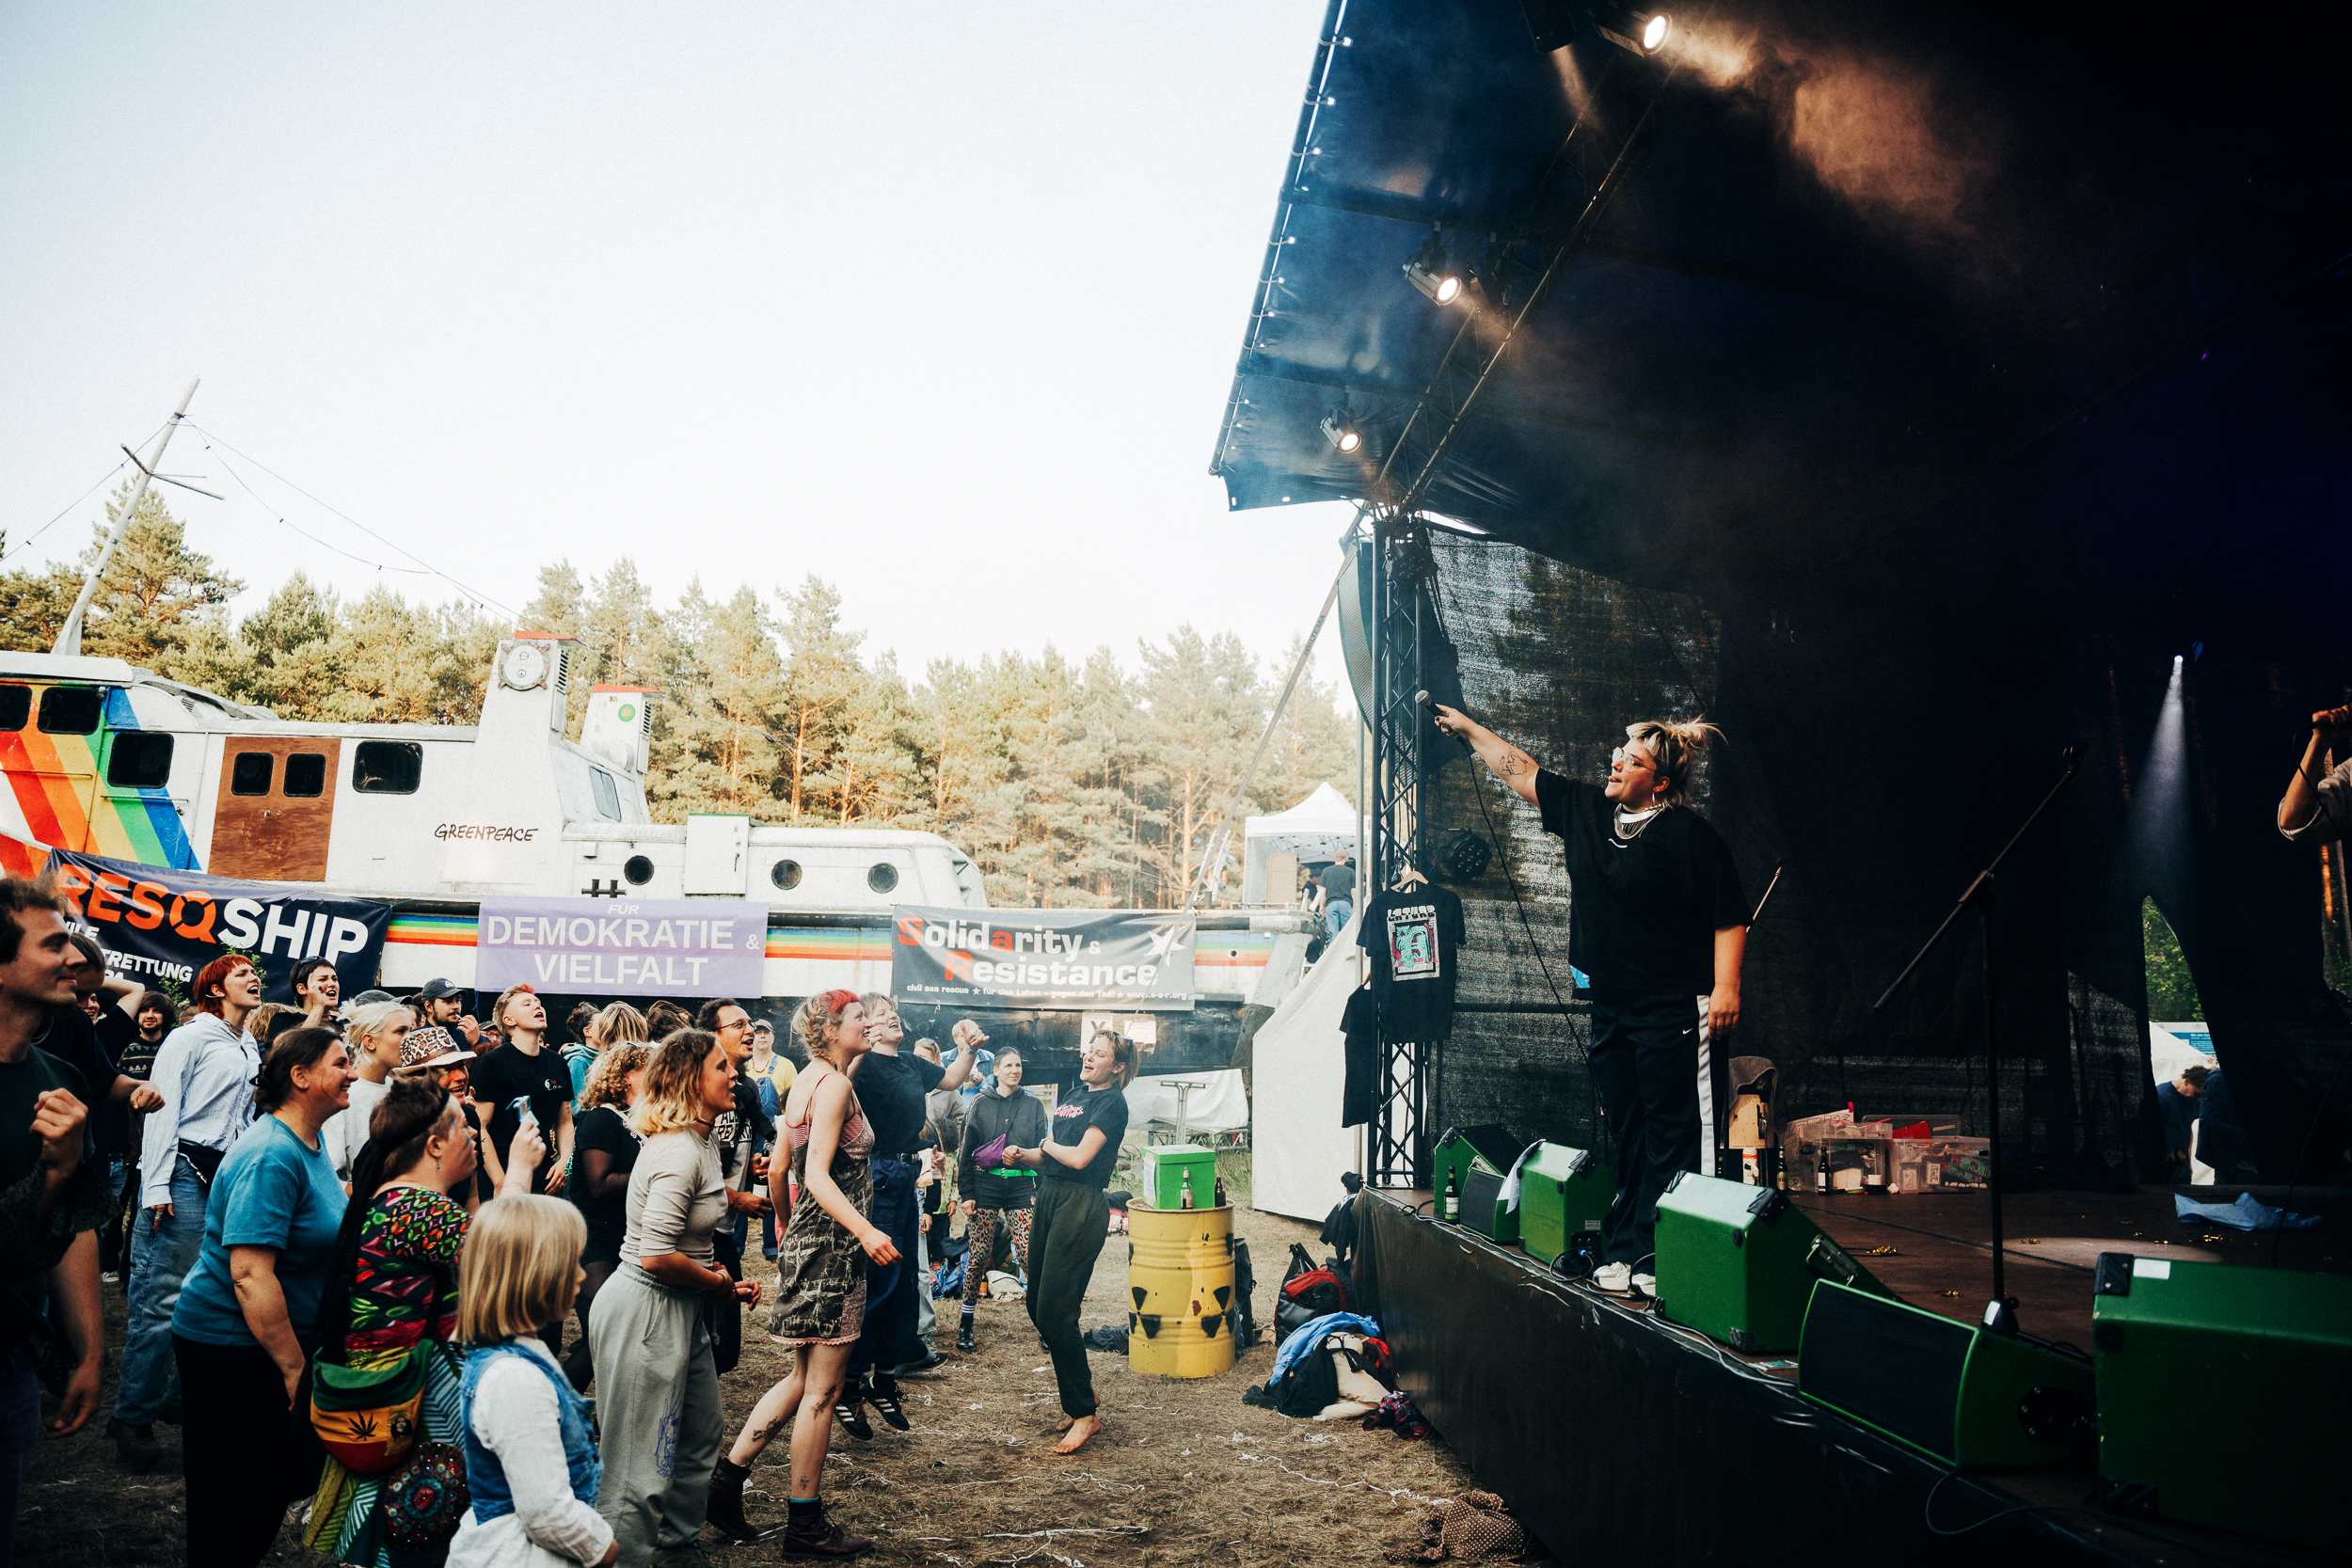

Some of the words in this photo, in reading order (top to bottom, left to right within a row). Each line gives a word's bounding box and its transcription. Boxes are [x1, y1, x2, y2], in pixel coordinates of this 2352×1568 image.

[434, 823, 539, 843] GREENPEACE
[55, 863, 369, 966] RESQSHIP
[608, 903, 640, 915] FÜR
[487, 915, 734, 950] DEMOKRATIE
[745, 933, 760, 950] &
[898, 915, 1083, 962] Solidarity
[1089, 941, 1101, 955] &
[100, 947, 193, 982] TRETTUNG
[533, 953, 709, 986] VIELFALT
[945, 951, 1158, 986] Resistance
[907, 983, 922, 992] civil
[942, 986, 969, 994] rescue
[983, 987, 995, 995] für
[998, 988, 1014, 996] das
[1051, 990, 1076, 999] gegen
[1078, 990, 1094, 998] den
[1097, 990, 1115, 998] Tod!
